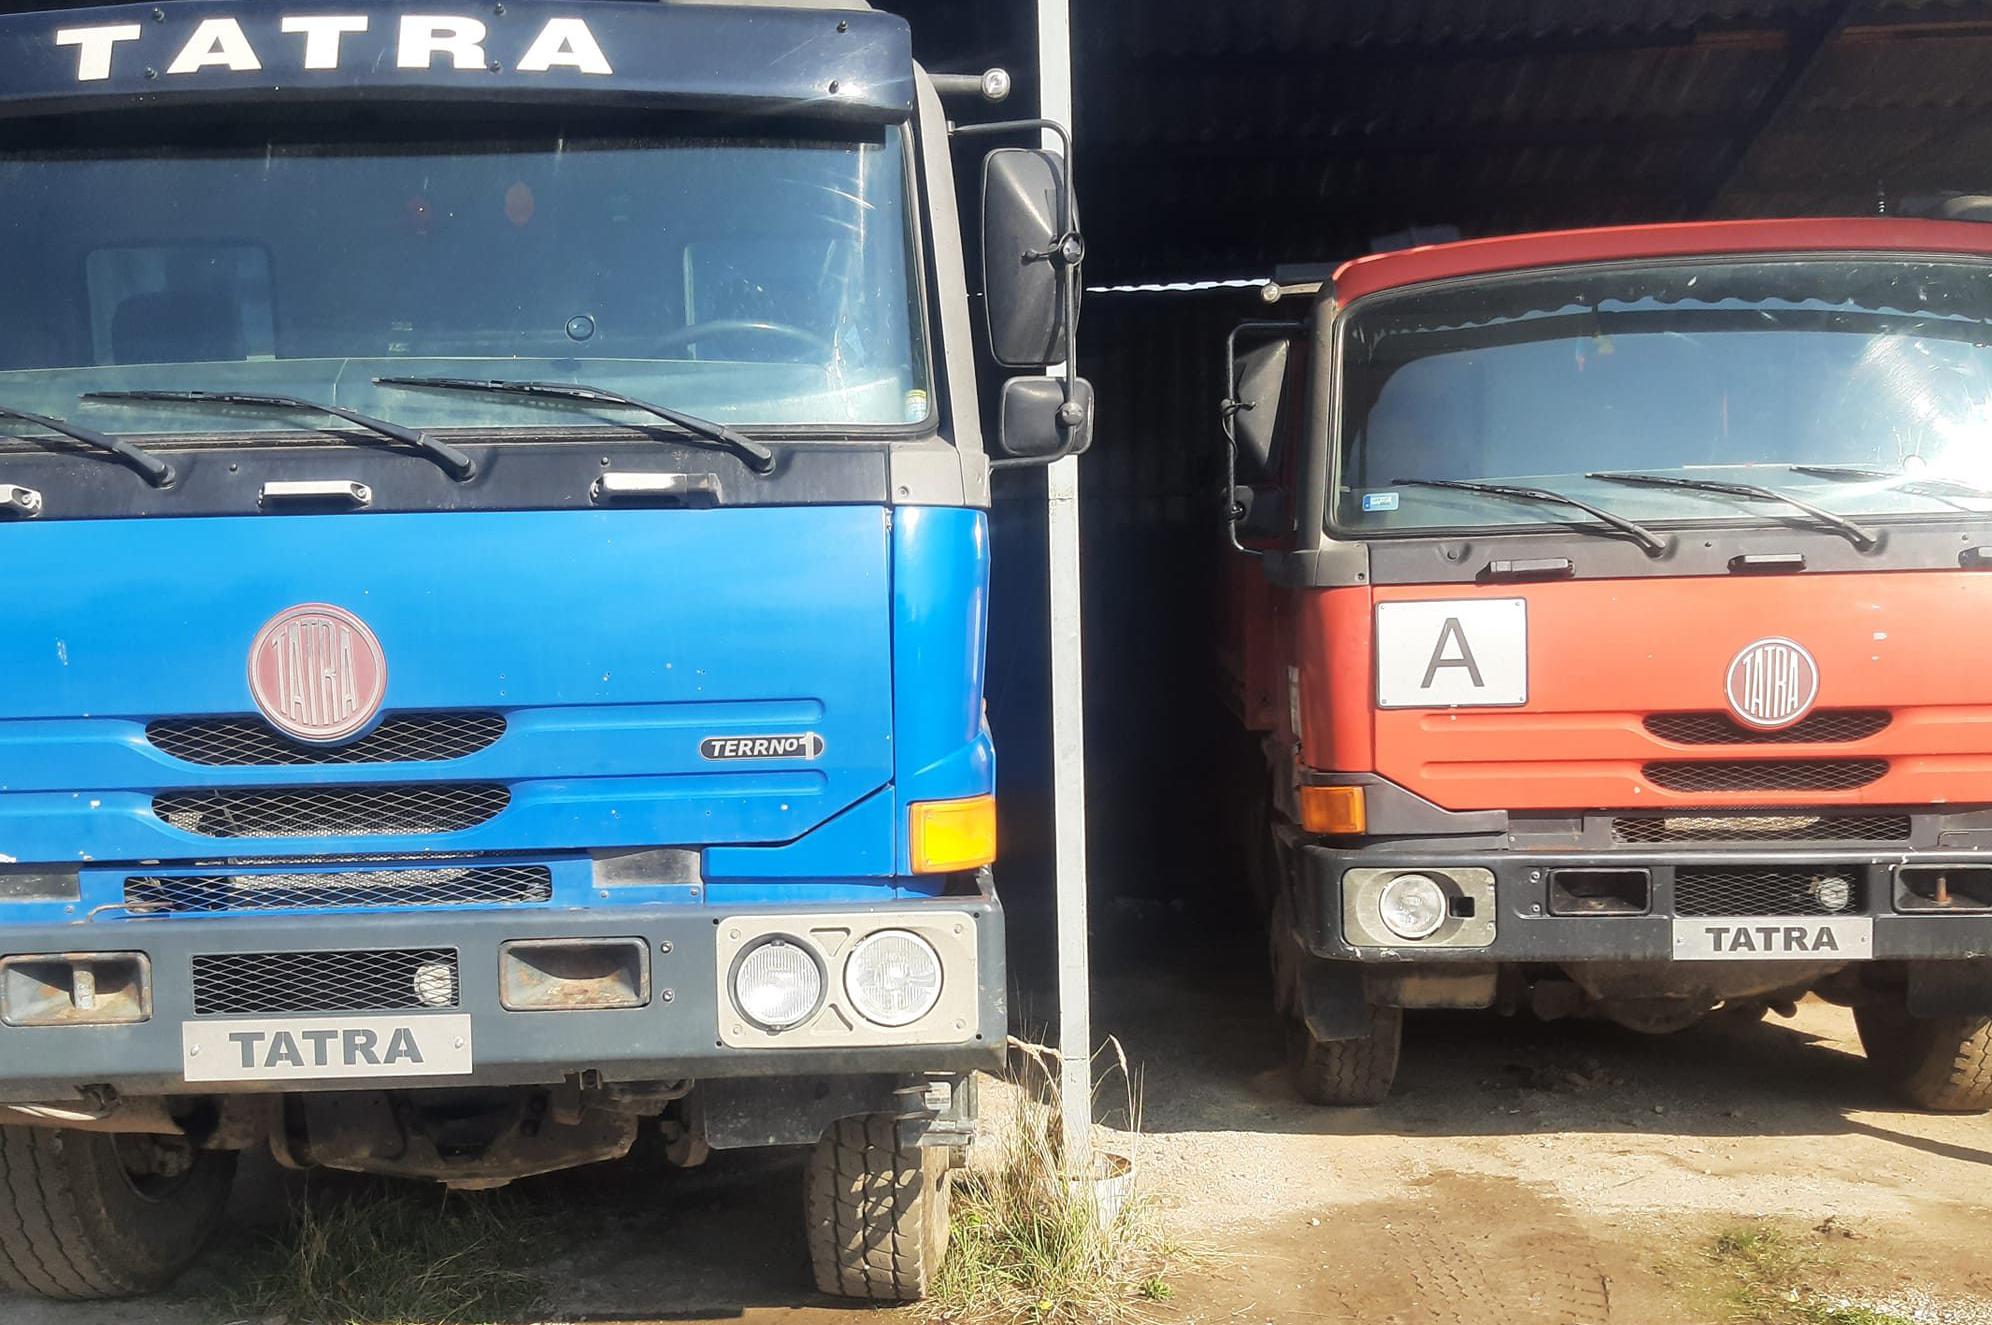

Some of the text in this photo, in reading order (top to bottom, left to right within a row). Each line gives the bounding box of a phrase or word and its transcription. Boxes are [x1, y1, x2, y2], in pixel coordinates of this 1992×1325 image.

[55, 15, 613, 81] TATRA
[272, 618, 358, 726] TATRA
[1420, 617, 1485, 689] A
[1742, 646, 1799, 718] TATRA
[1704, 926, 1840, 952] TATRA
[229, 1028, 424, 1068] TATRA
